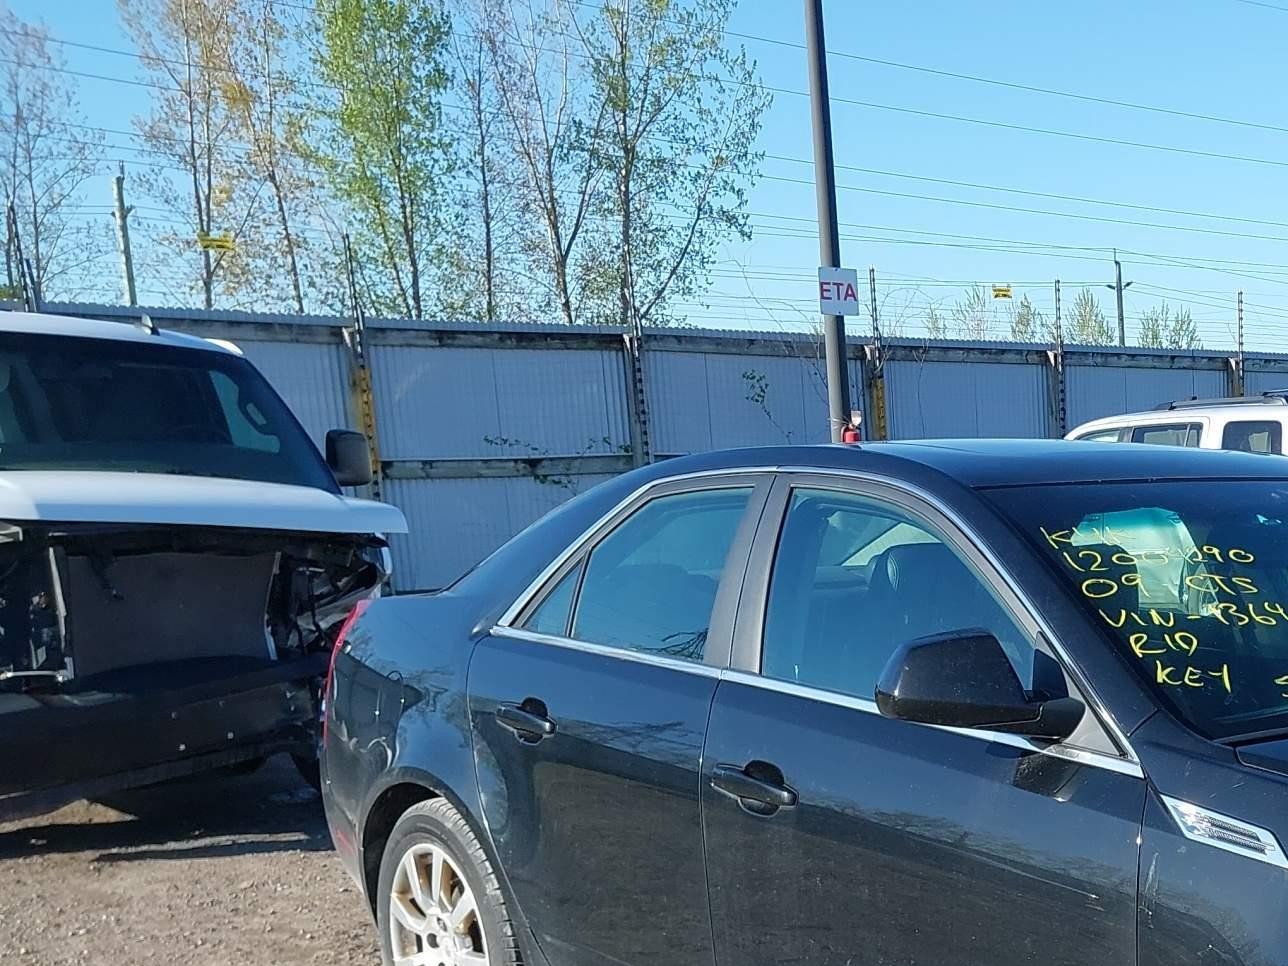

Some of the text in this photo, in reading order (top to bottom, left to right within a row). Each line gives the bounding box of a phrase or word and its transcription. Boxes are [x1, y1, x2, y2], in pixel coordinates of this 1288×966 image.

[820, 281, 857, 302] ETA
[1081, 573, 1258, 598] 09 CTS
[1155, 659, 1233, 694] KEY
